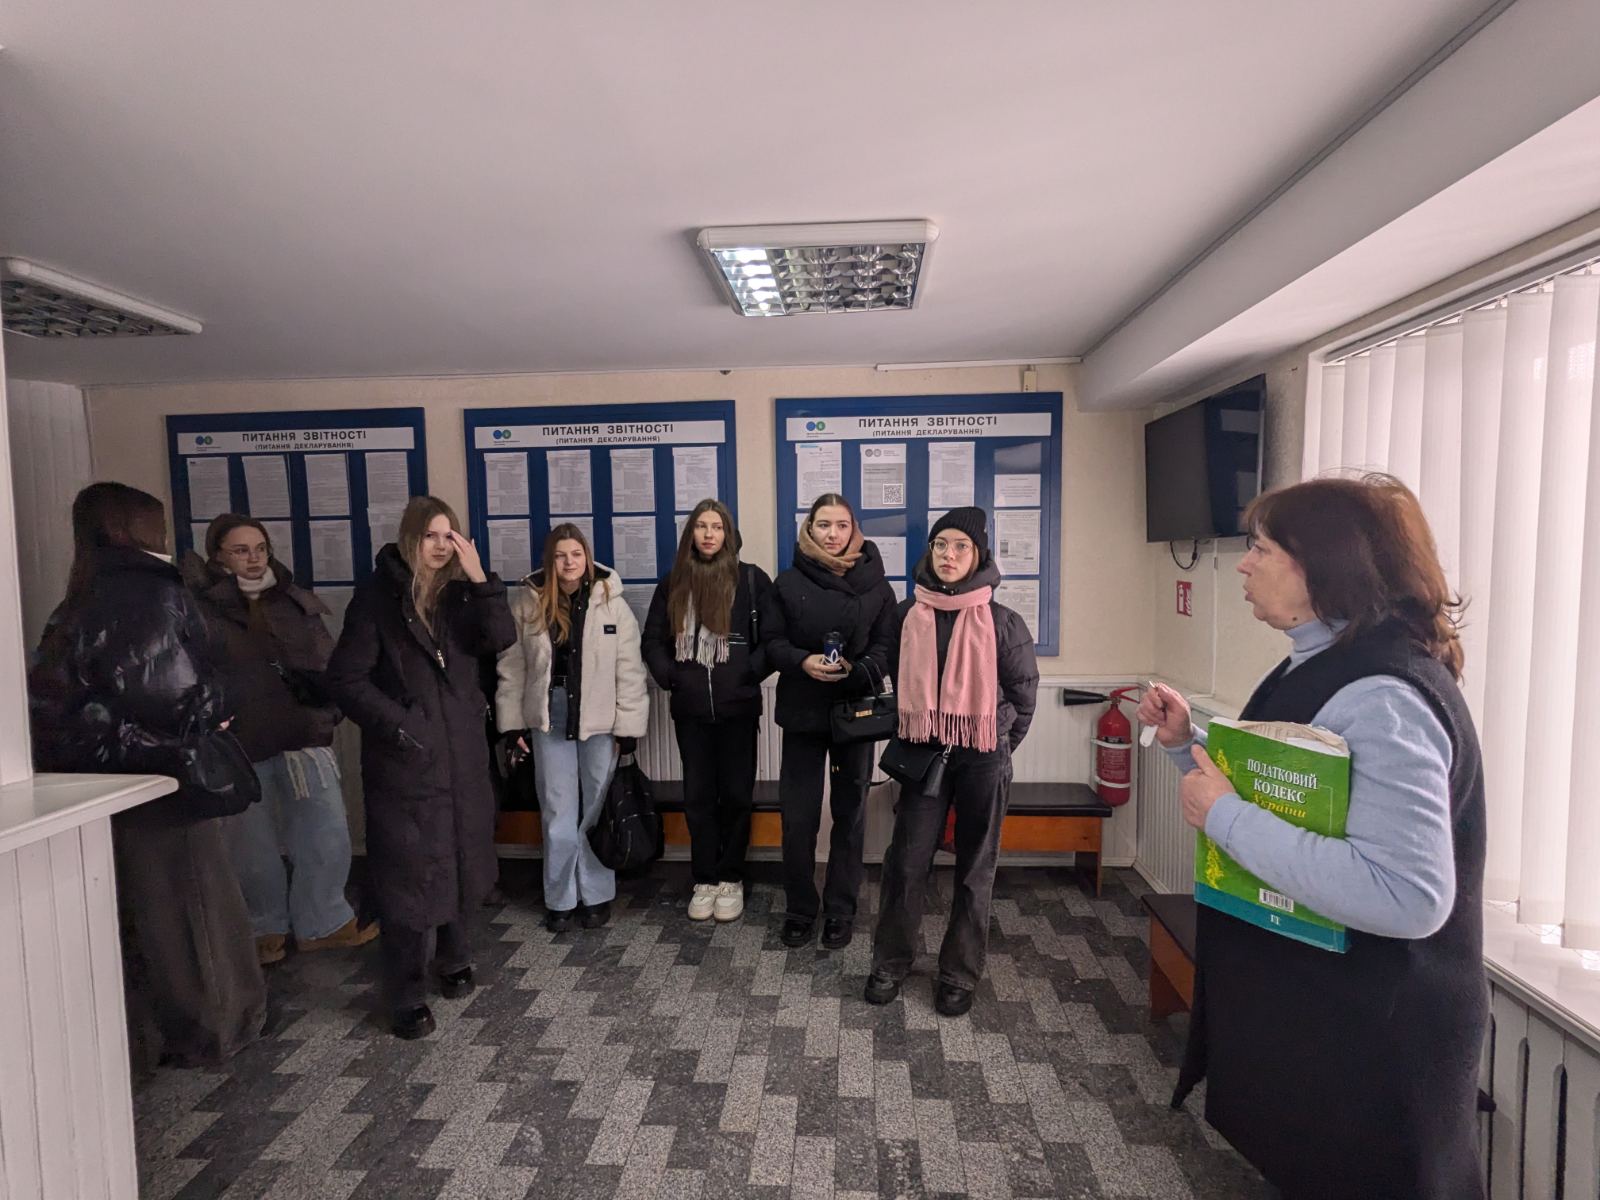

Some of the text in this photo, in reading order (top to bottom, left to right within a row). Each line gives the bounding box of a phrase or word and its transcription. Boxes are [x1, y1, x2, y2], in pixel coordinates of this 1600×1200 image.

[859, 415, 998, 428] ПИТАННЯ ЗВІТНОСТІ
[542, 423, 674, 436] ПИТАННЯ ЗВІТНОСТІ
[872, 428, 983, 437] (ПИТАННЯ ДЕКЛАРУВАННЯ)
[242, 430, 367, 442] ПИТАННЯ ЗВІТНОСТІ
[556, 435, 660, 445] (ПИТАННЯ ДЕКЛАРУВАННЯ)
[255, 441, 354, 451] (ПИТАННЯ ДЕКЛАРУВАННЯ)
[1247, 758, 1318, 790] ПОДАТКОВИЙ
[1253, 778, 1306, 804] КОДЕКС
